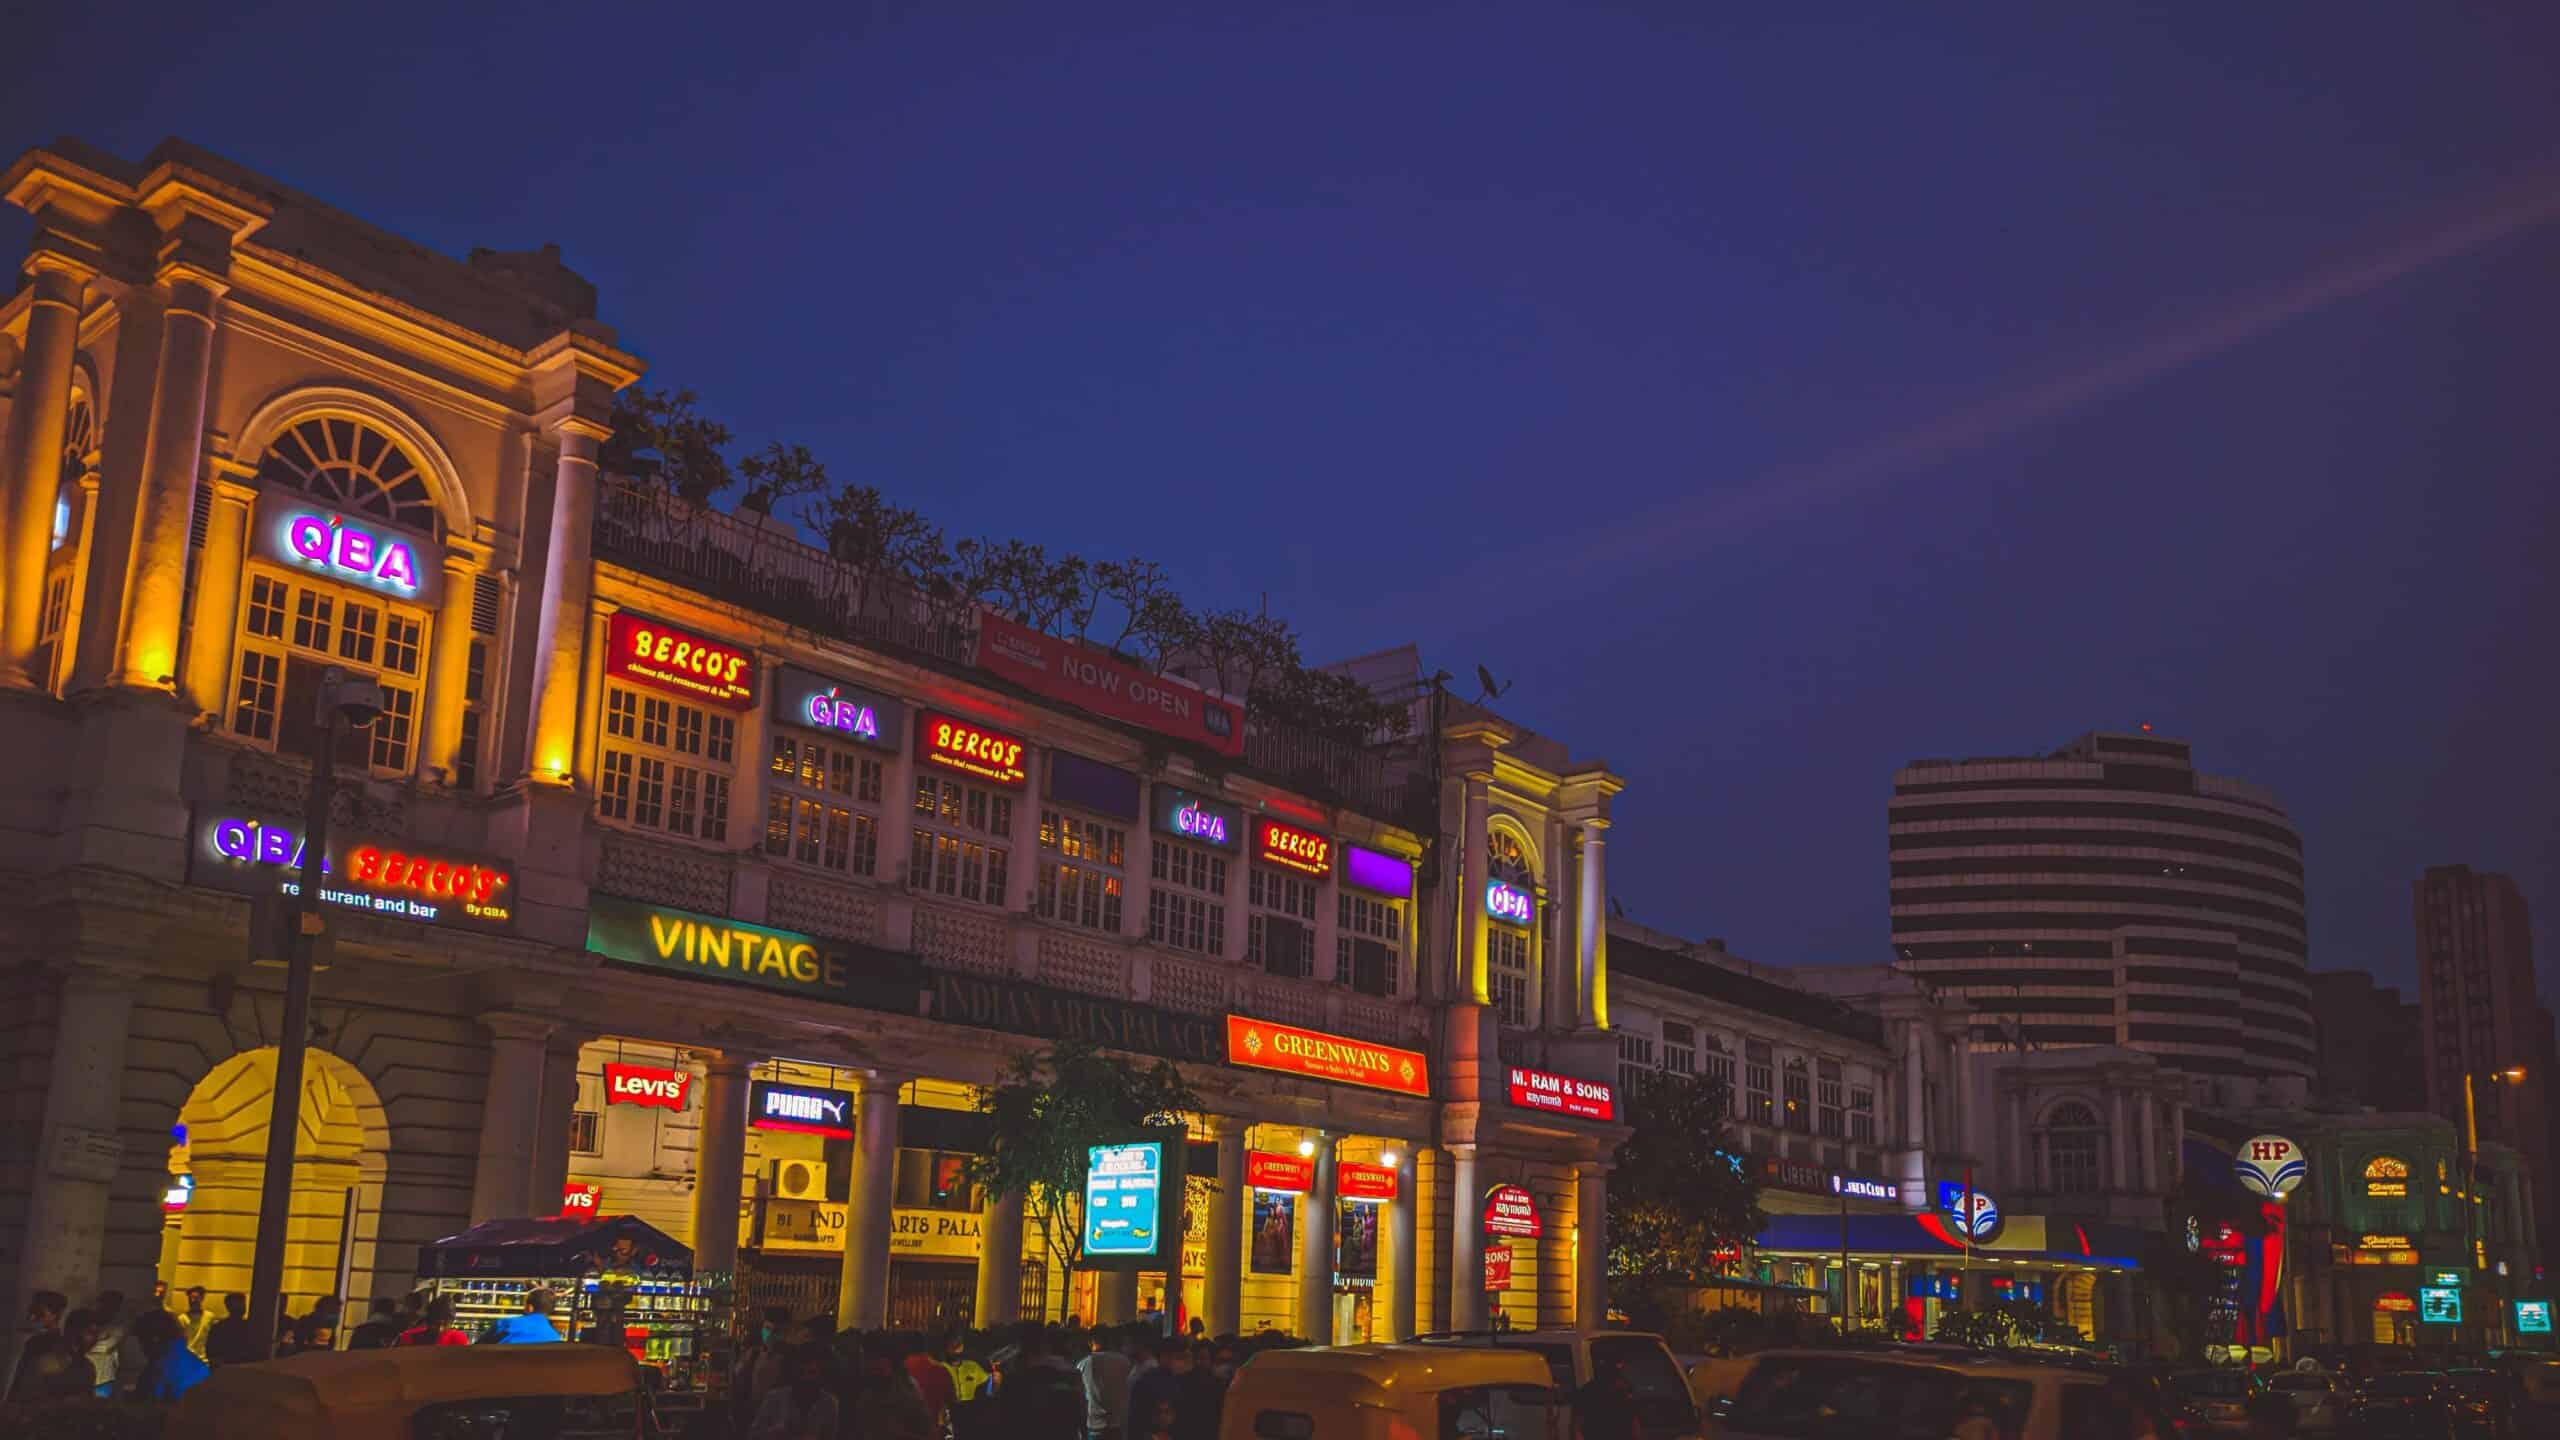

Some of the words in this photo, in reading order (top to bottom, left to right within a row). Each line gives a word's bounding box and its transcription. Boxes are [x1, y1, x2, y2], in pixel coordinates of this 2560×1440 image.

[635, 630, 741, 682] BERCO'S
[1062, 655, 1121, 696] NOW
[1128, 680, 1191, 719] OPEN
[937, 723, 1021, 767] BERCO'S
[1269, 827, 1328, 862] BERCO'S
[356, 847, 501, 901] BERCO'S
[280, 880, 372, 908] reaurant
[374, 895, 405, 914] and
[409, 899, 438, 919] bar
[466, 903, 481, 915] By
[651, 915, 848, 988] VINTAGE
[939, 975, 1041, 1026] INDIAN
[1274, 1032, 1391, 1073] GREENWAYS
[766, 1092, 821, 1119] PUMA
[1512, 1069, 1528, 1087] M.
[1531, 1072, 1560, 1093] RAM
[1563, 1079, 1573, 1094] &
[1576, 1081, 1610, 1102] SONS
[2252, 1142, 2290, 1161] HP
[809, 1210, 845, 1229] IND
[937, 1218, 981, 1238] PALA
